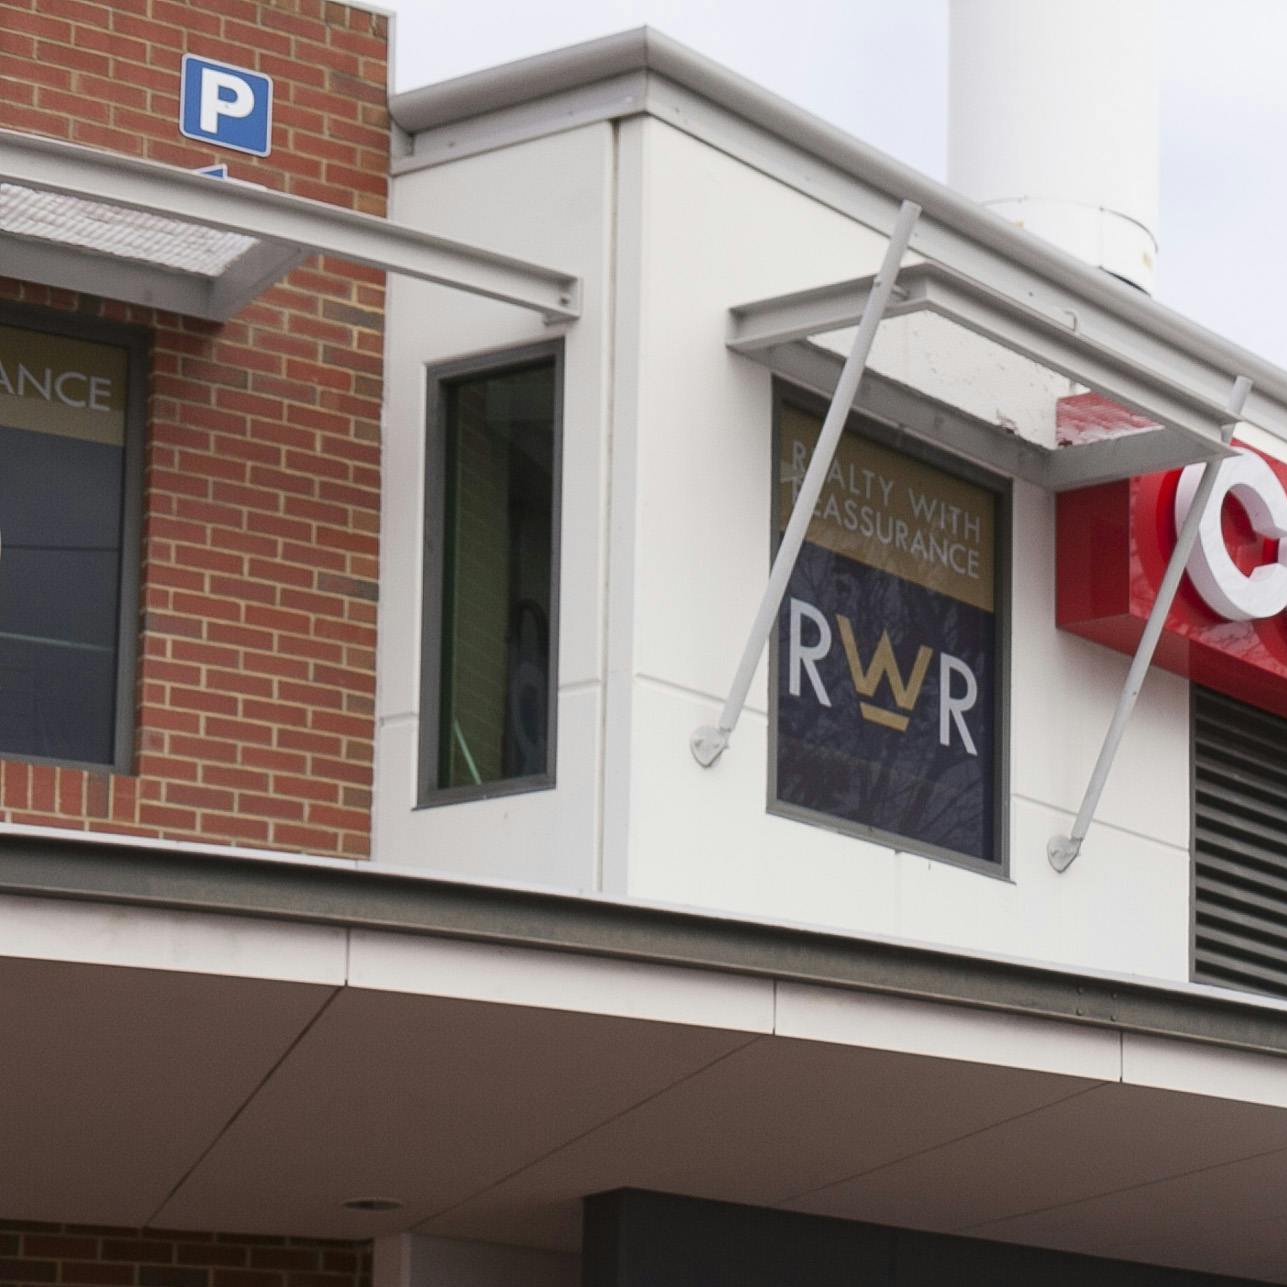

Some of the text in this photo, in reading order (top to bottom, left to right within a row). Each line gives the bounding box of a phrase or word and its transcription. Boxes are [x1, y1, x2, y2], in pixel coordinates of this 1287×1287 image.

[199, 67, 255, 135] P
[792, 440, 981, 544] RALTY WITH
[788, 596, 979, 757] RWR
